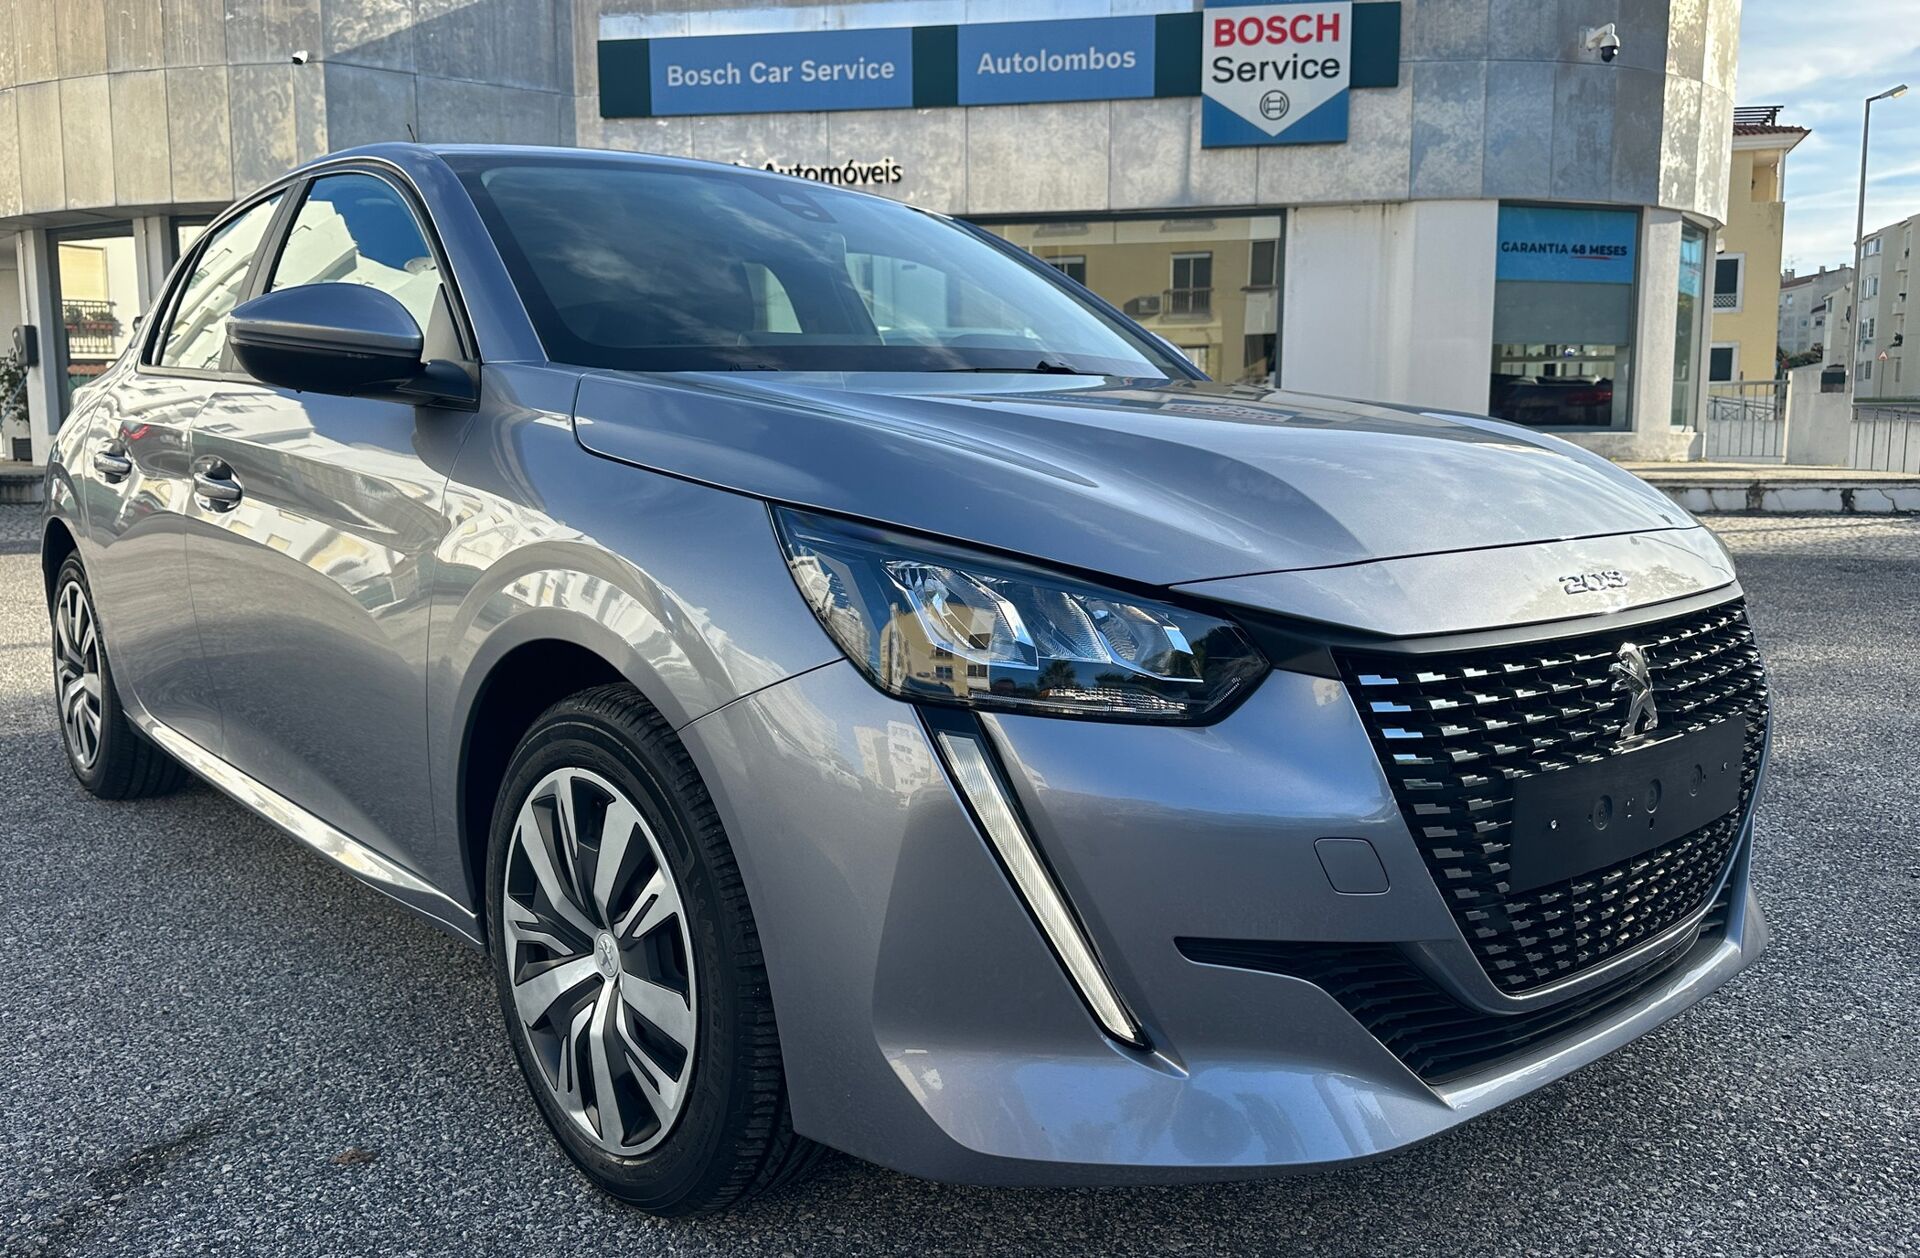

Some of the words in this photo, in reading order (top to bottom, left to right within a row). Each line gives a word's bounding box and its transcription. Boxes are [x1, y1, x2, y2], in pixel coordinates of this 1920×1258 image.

[1214, 14, 1341, 47] BOSCH
[668, 63, 740, 87] Bosch
[749, 62, 793, 83] Car
[801, 57, 896, 82] Service
[977, 47, 1136, 75] Autolombos
[1212, 53, 1341, 84] Service
[1501, 242, 1568, 255] GARANTIA
[1571, 245, 1586, 255] 48
[1589, 245, 1628, 256] MESES
[1559, 570, 1628, 595] 208
